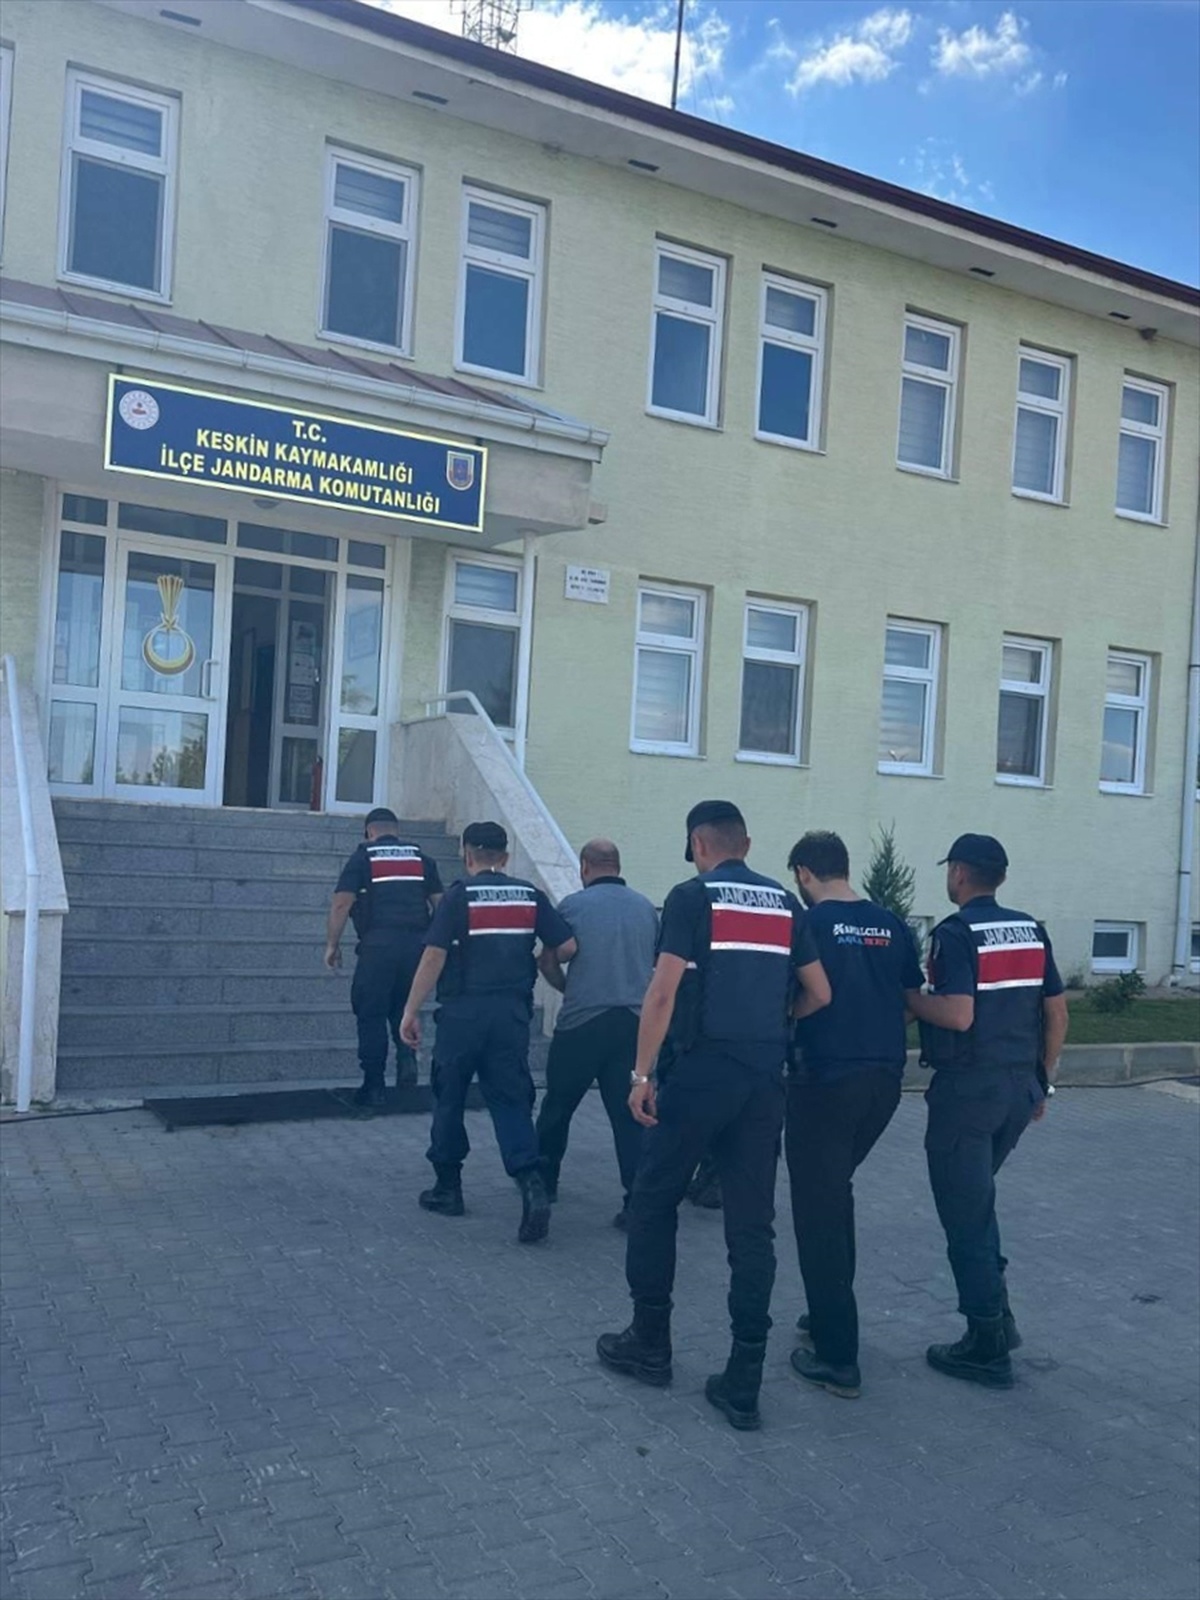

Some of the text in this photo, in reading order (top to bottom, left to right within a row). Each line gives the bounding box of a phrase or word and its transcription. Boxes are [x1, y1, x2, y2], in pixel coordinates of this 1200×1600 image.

[292, 420, 327, 443] T.C.
[196, 428, 413, 485] KESKİN KAYMAKAMLIĞI
[160, 444, 440, 514] İLÇE JANDARMA KOMUTANLIĞI
[476, 889, 530, 902] JANDARMA
[717, 886, 785, 909] JANDARMA
[984, 927, 1038, 946] JANDARMA
